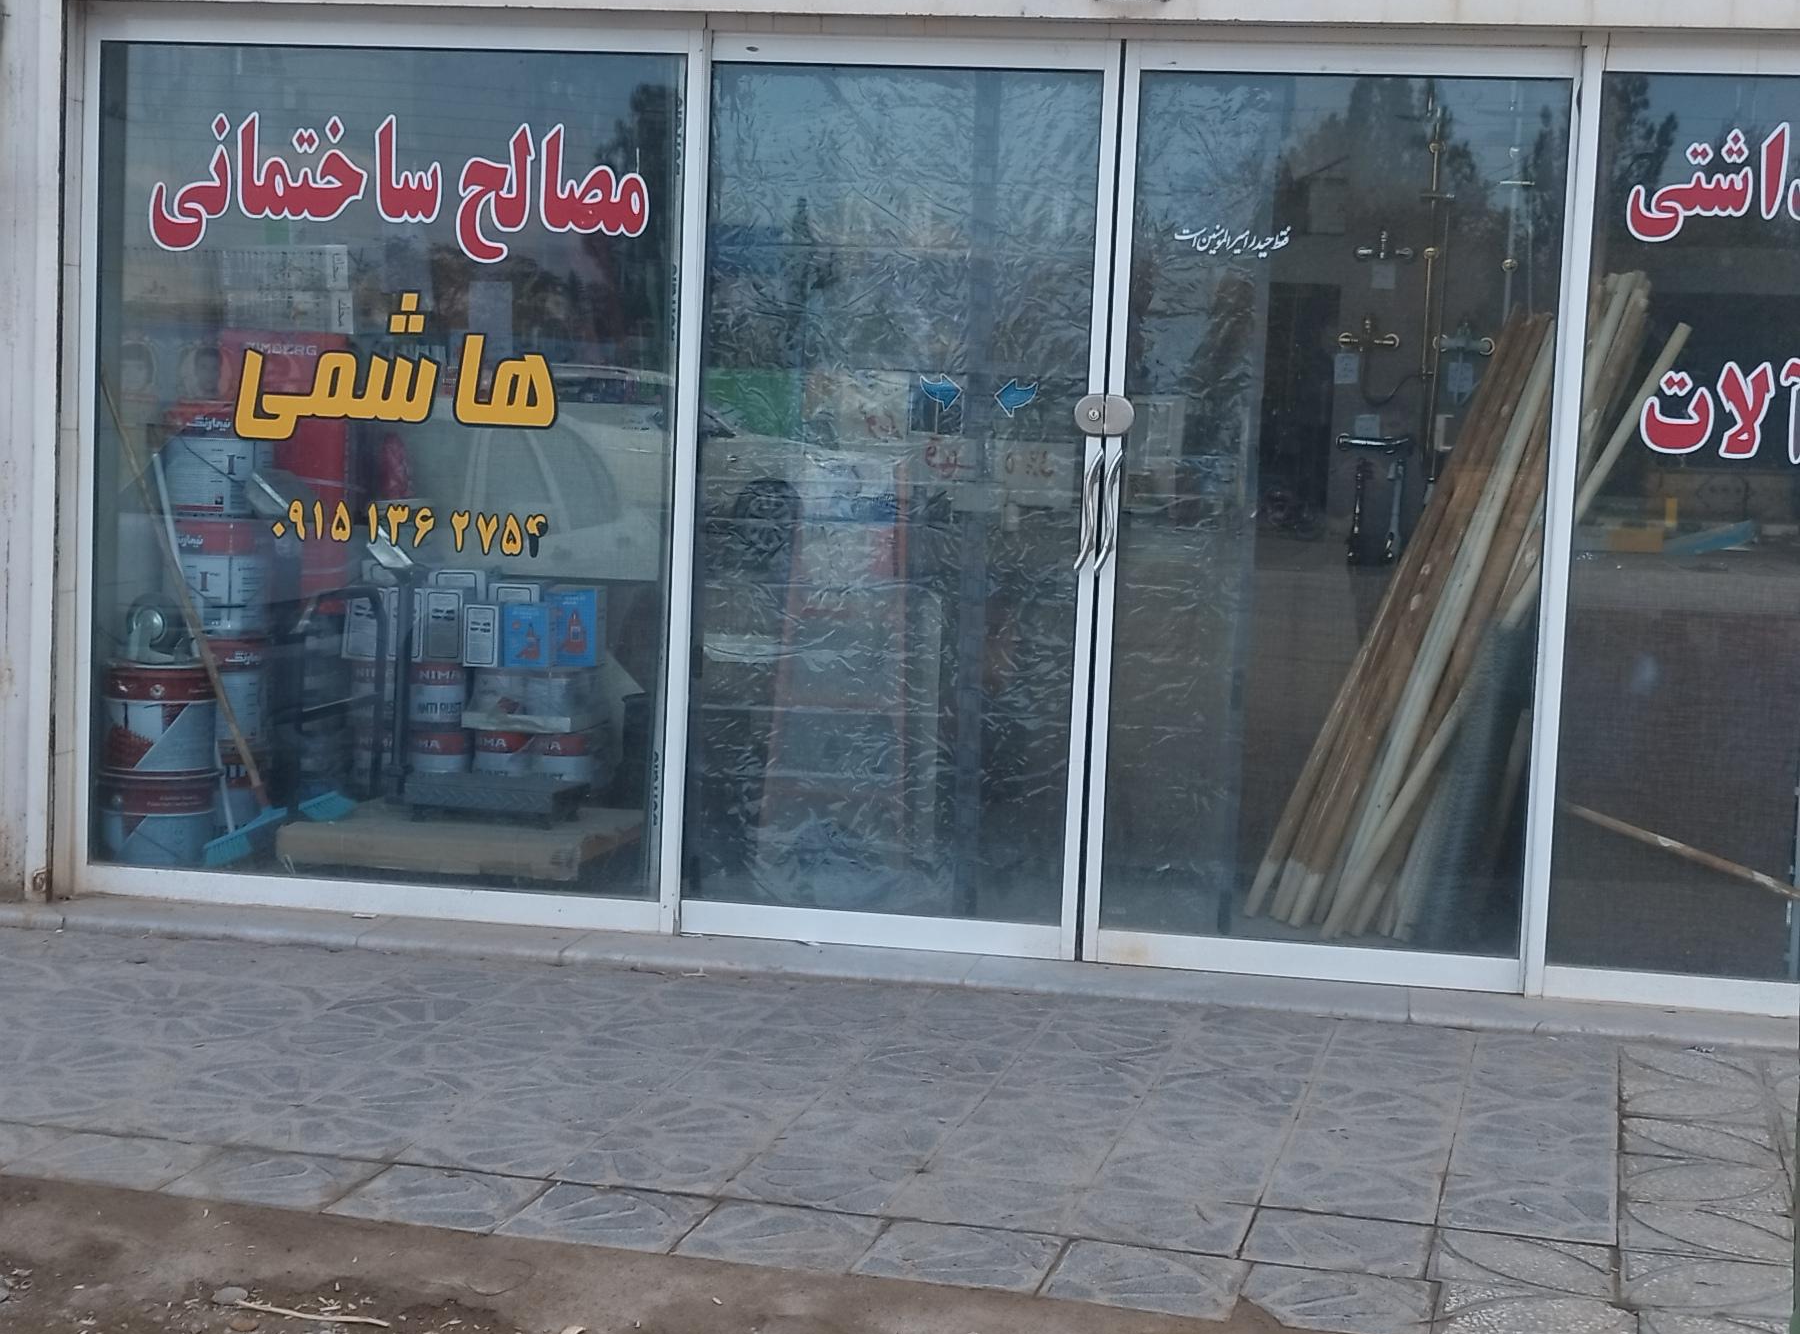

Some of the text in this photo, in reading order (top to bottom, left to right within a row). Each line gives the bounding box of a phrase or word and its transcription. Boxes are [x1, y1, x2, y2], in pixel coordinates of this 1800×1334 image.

[149, 113, 443, 251] ساختمانی
[456, 123, 649, 263] مصالح
[1174, 227, 1207, 248] است
[1249, 235, 1275, 258] حیدر
[1271, 225, 1292, 250] فقط
[234, 291, 557, 441] هاشمی
[270, 499, 549, 559] ۰۹۱۵ ۱۳۶ ۲۷۵۴
